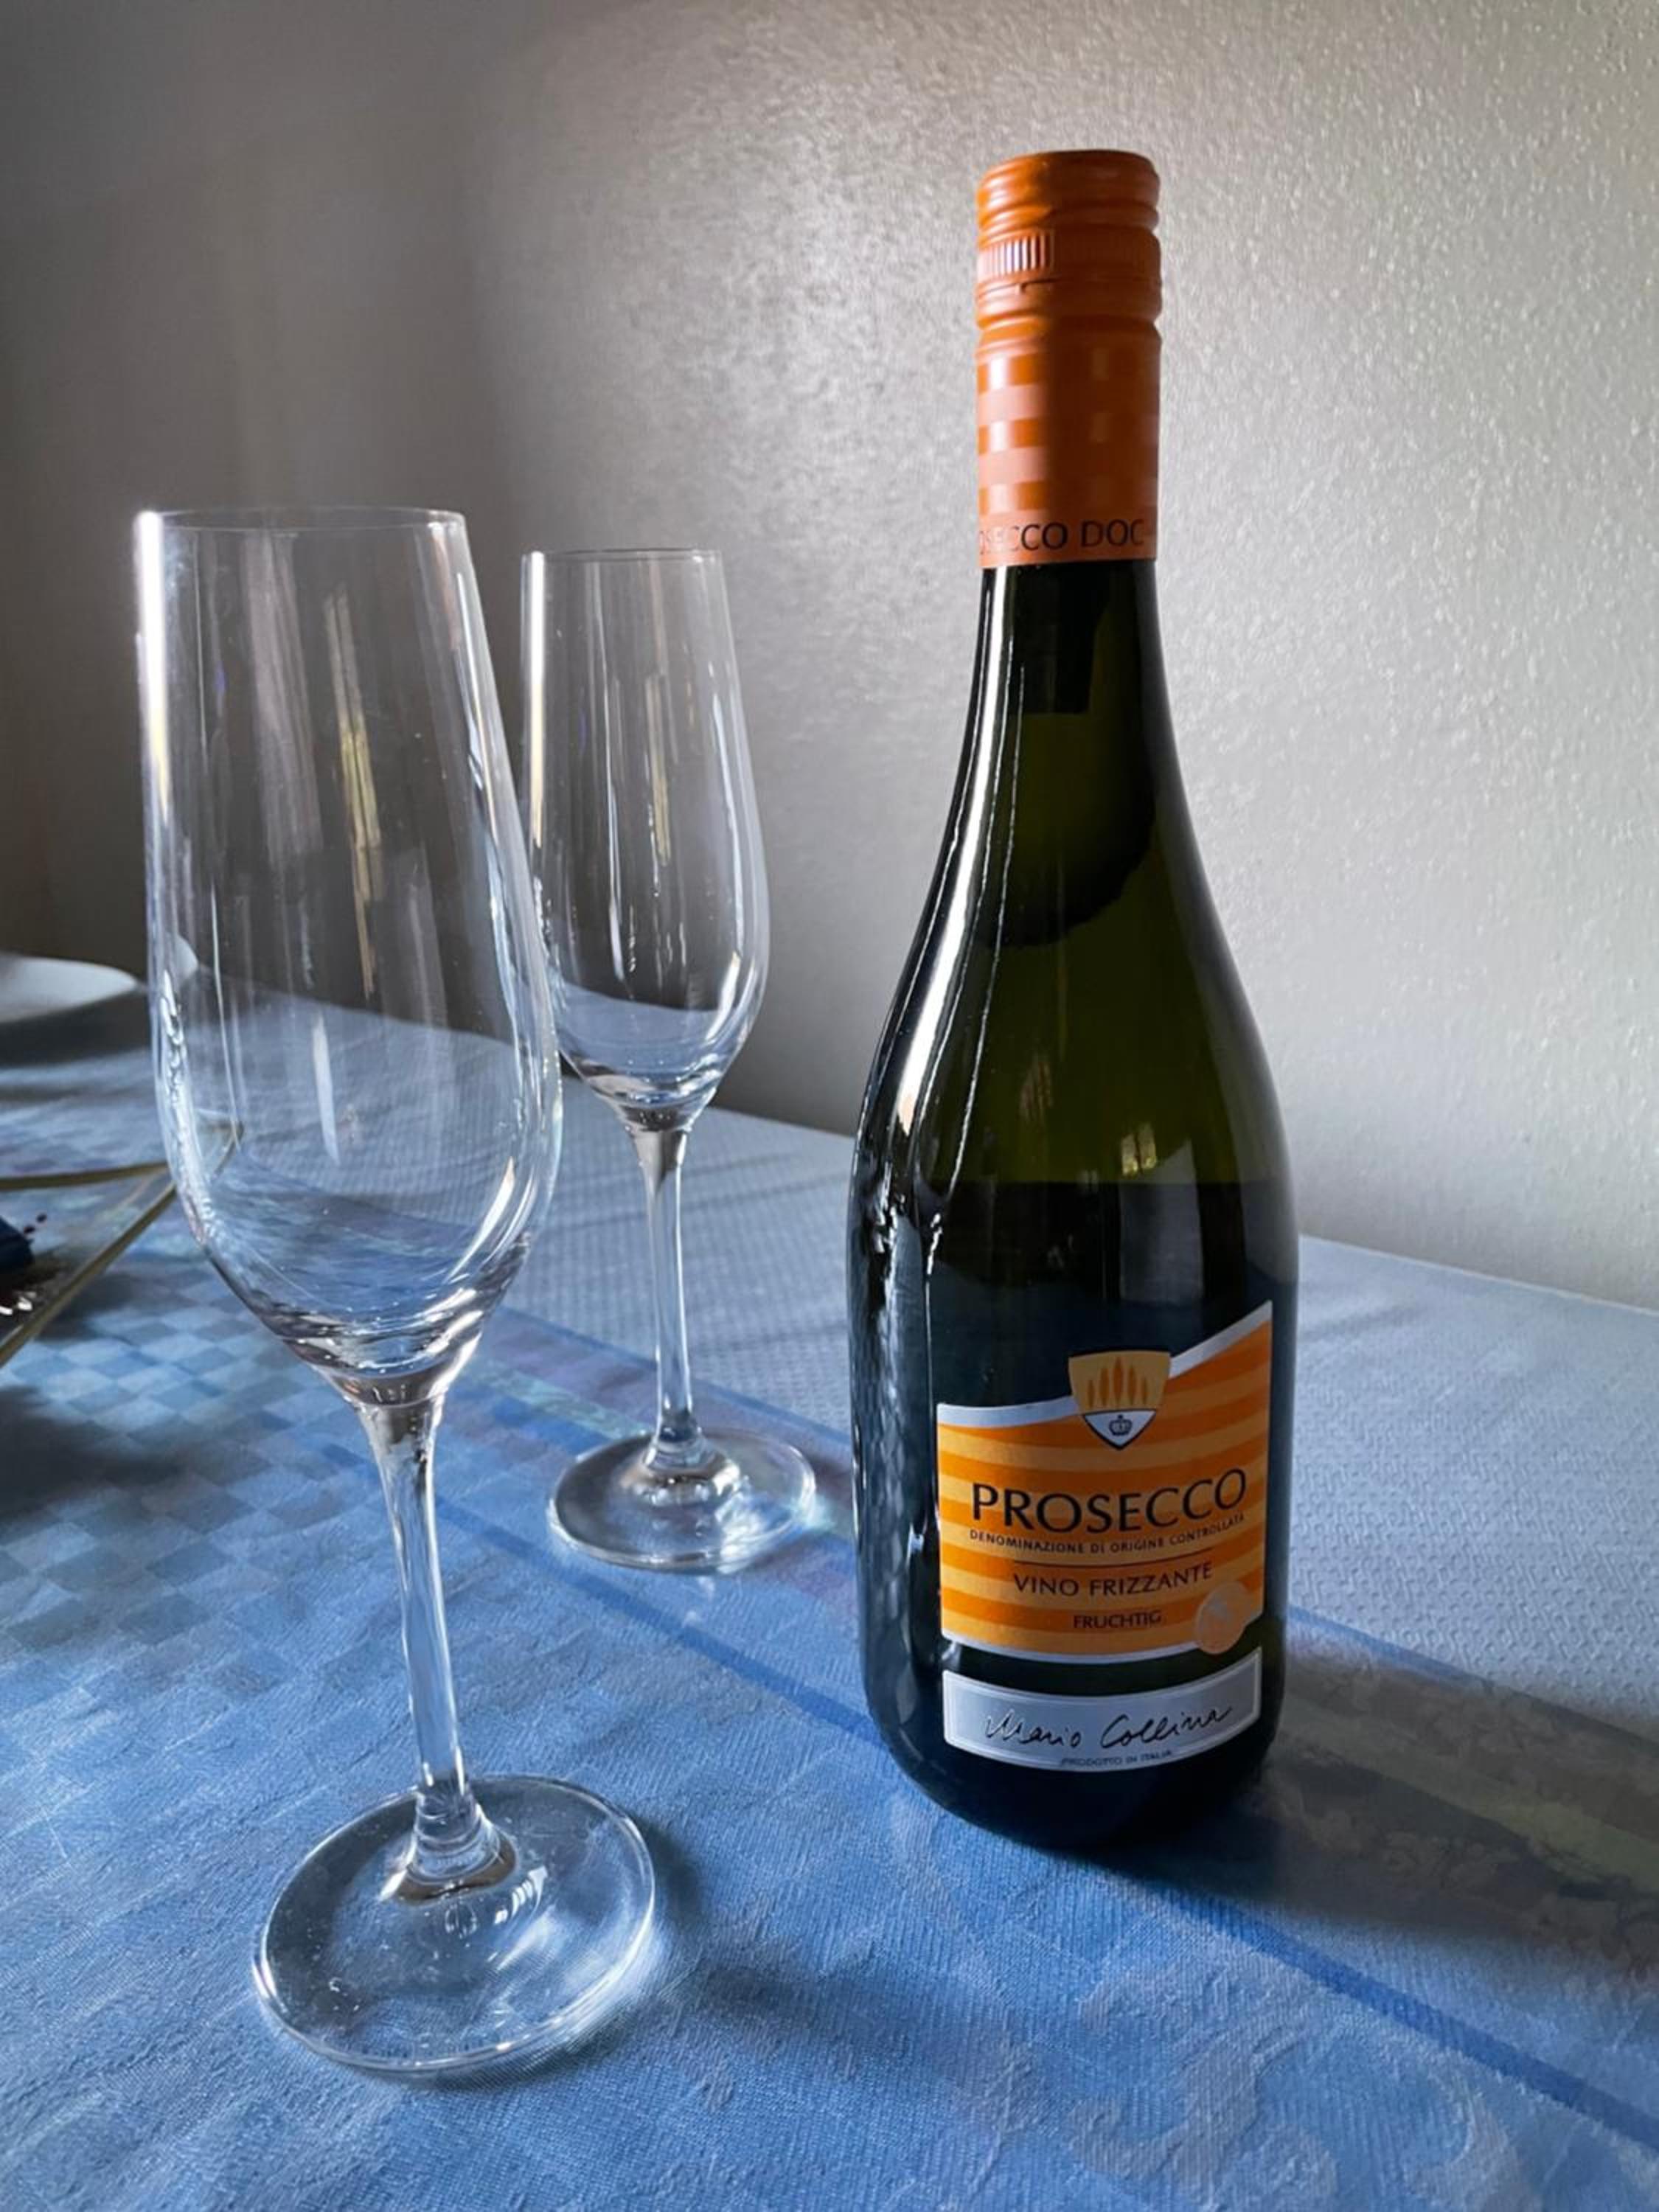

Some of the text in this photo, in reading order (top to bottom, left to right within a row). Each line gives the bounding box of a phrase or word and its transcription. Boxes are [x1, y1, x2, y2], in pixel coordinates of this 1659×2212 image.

[1081, 518, 1144, 548] DOC
[972, 1467, 1247, 1534] PROSECCO
[970, 1512, 1245, 1554] DENOMINAZIONE DI ORIGINE CONTROLLATA
[1013, 1561, 1213, 1597] VINO FRIZZANTE
[1073, 1610, 1162, 1630] FRUCHTIG
[985, 1705, 1233, 1749] Mario Collina
[1060, 1750, 1172, 1767] PRODOTTO IN ITALIA
